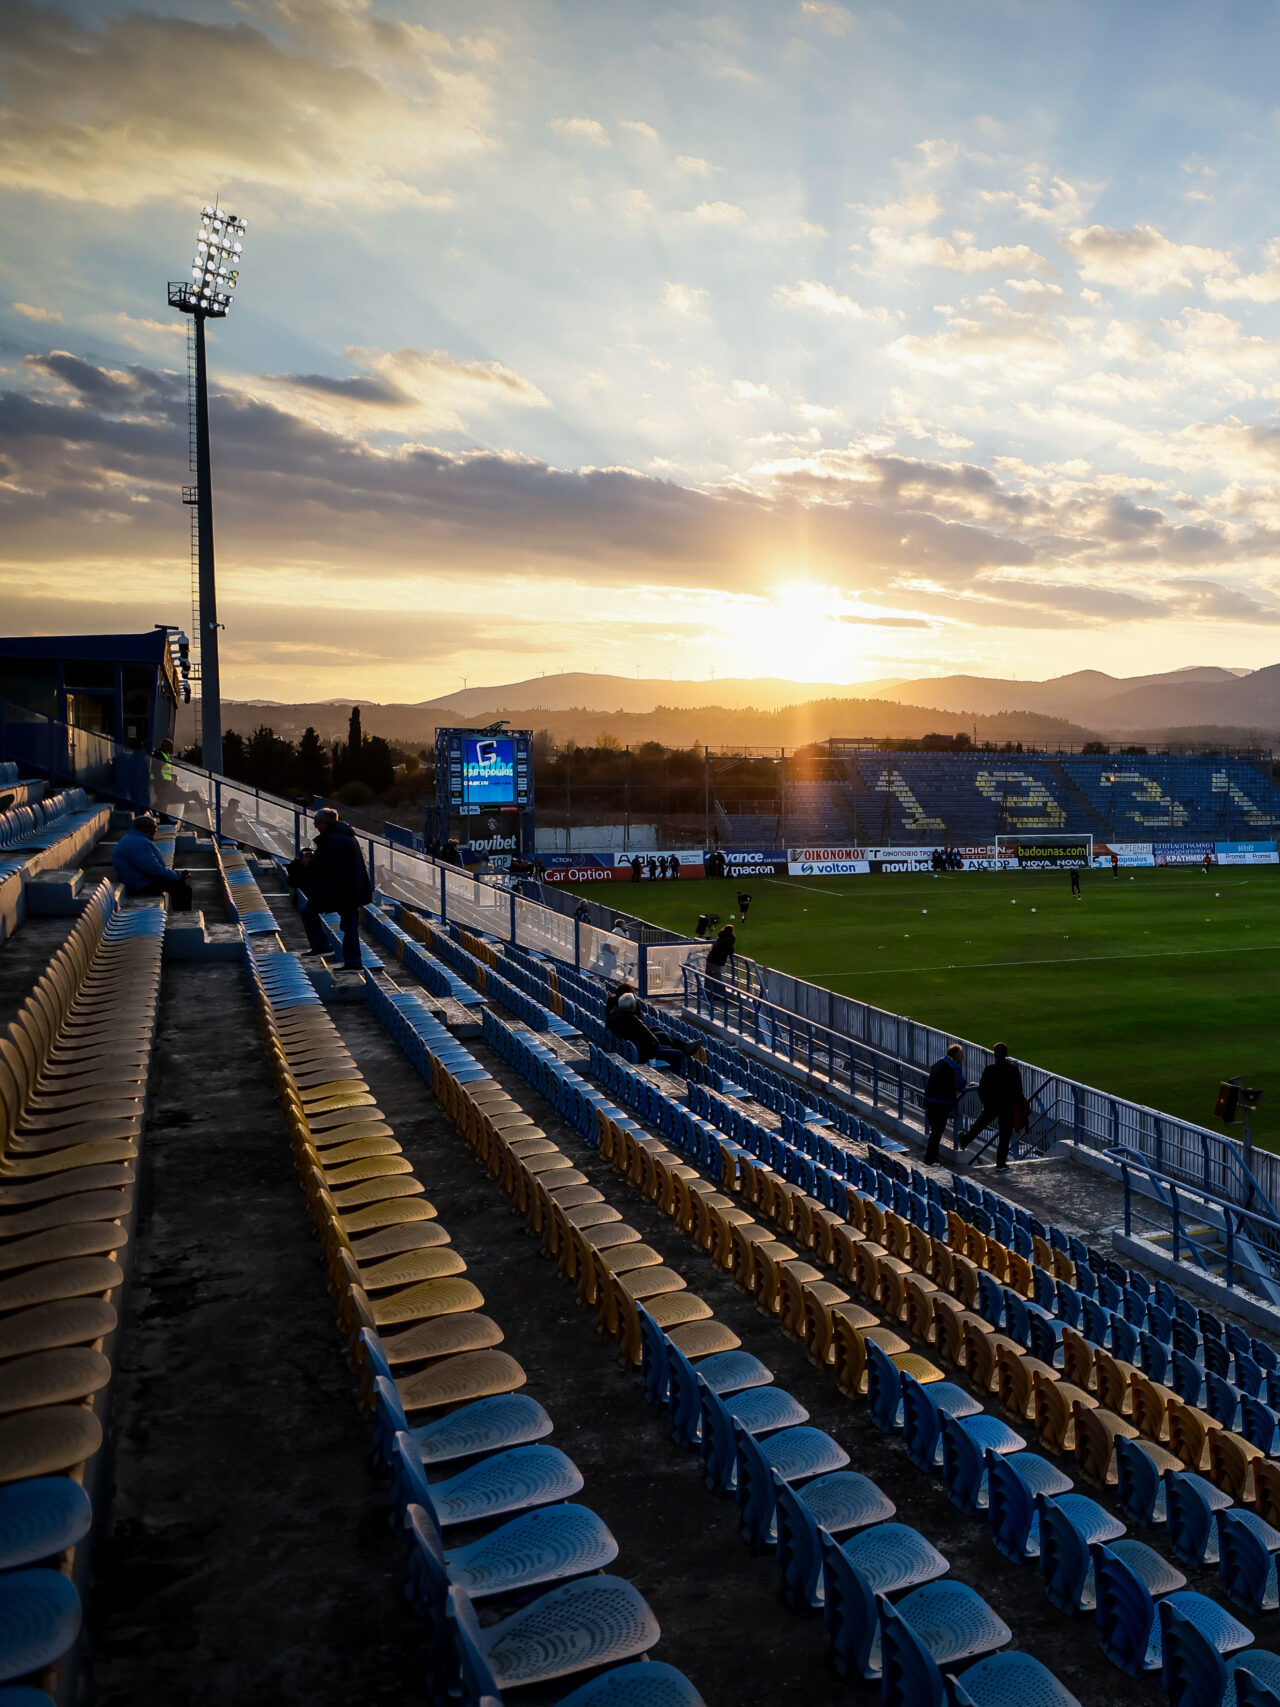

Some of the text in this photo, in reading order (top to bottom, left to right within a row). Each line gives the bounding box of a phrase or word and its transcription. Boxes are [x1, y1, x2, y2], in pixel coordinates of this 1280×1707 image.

[469, 834, 517, 851] novibet
[1018, 845, 1086, 856] badounas.com
[731, 865, 775, 876] macron
[817, 863, 856, 873] volton
[881, 859, 935, 873] novibet
[544, 868, 613, 882] Car Option
